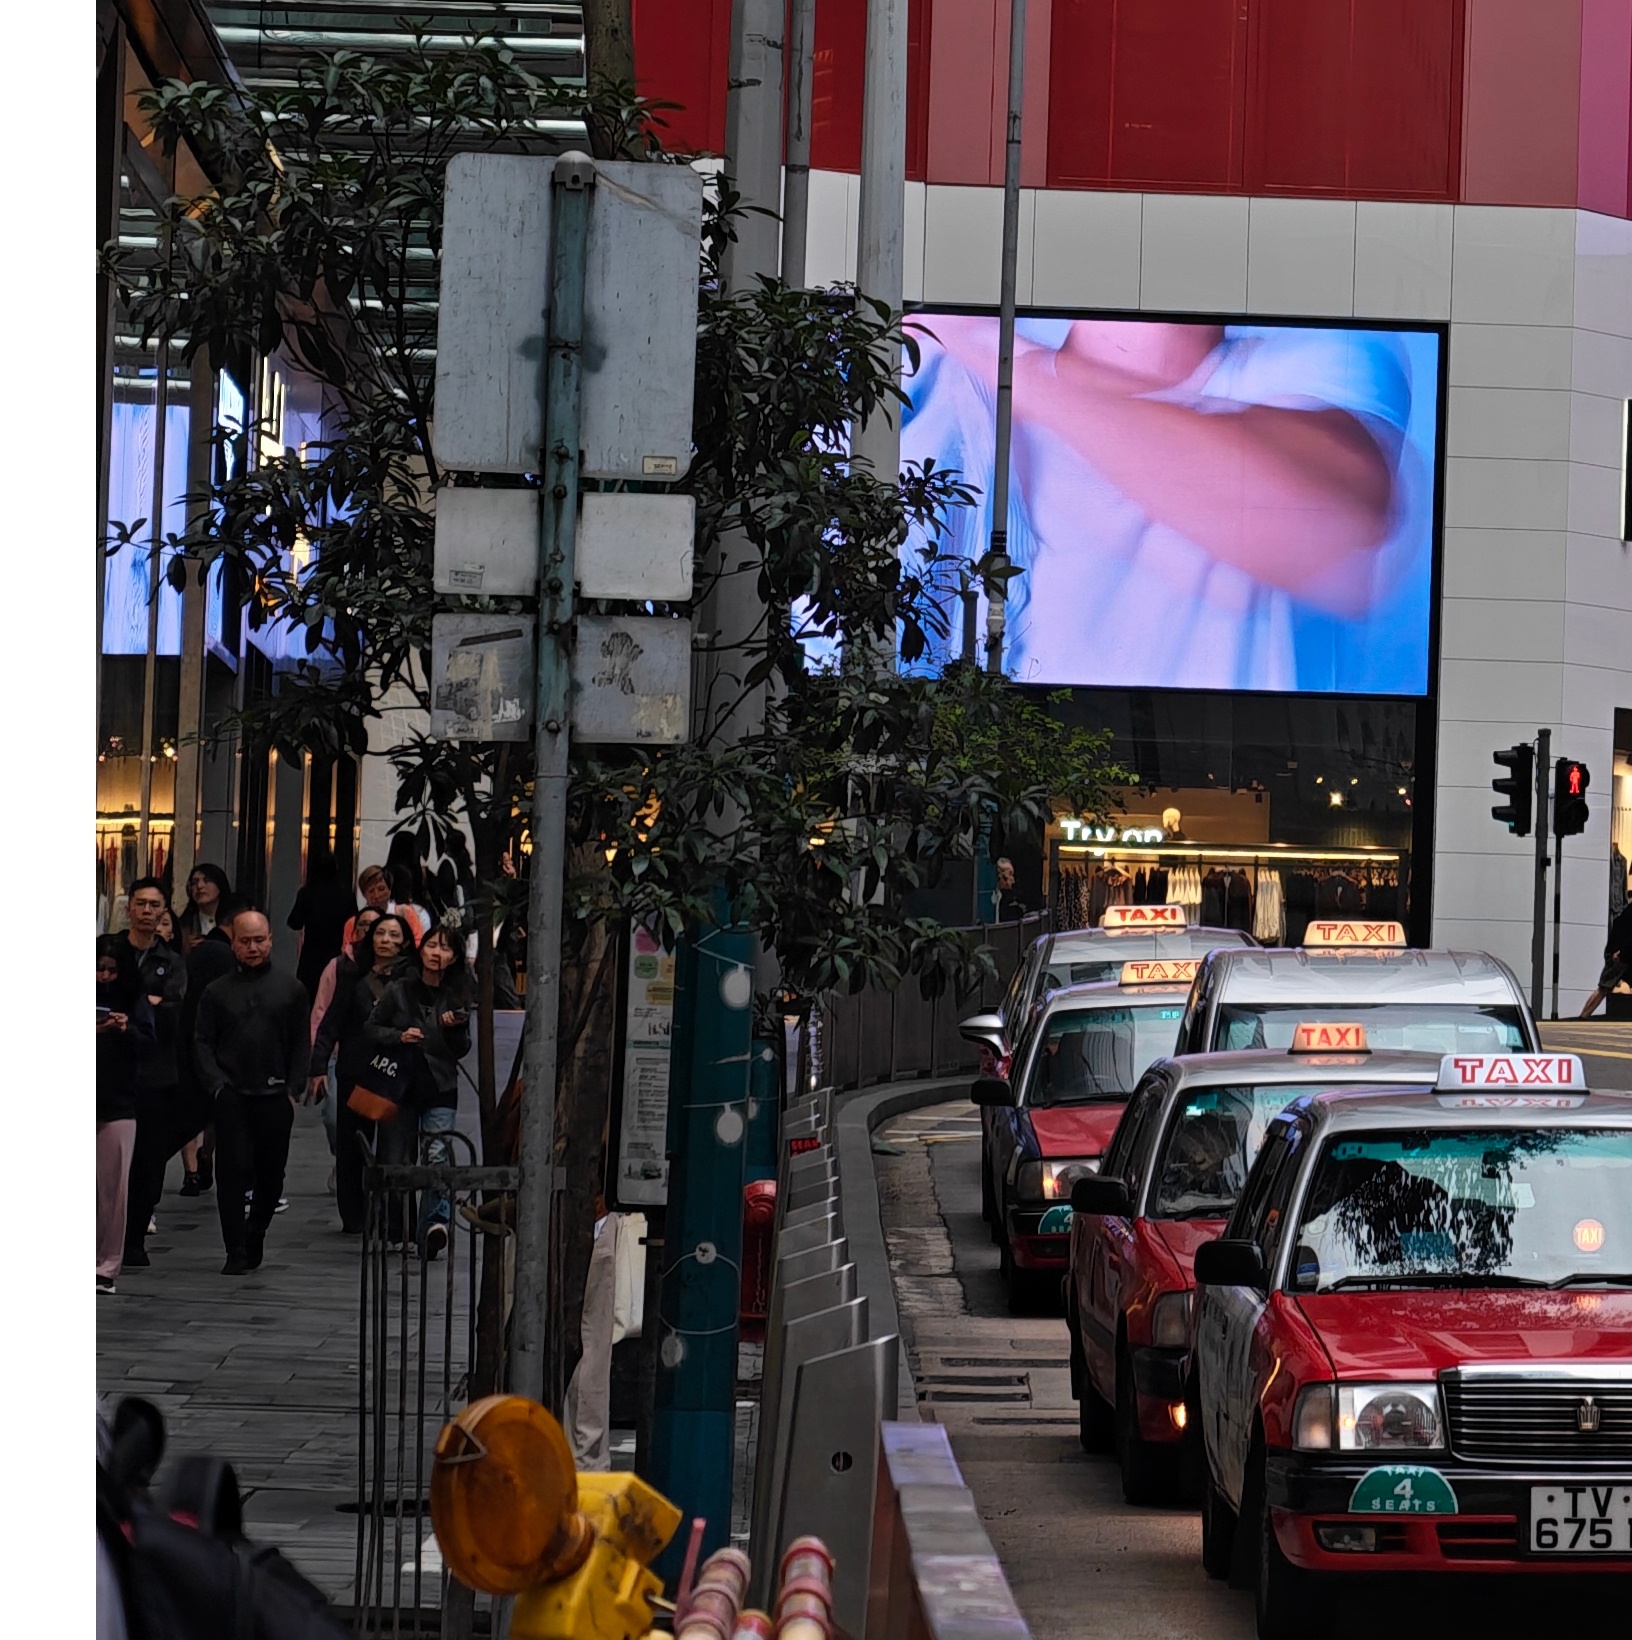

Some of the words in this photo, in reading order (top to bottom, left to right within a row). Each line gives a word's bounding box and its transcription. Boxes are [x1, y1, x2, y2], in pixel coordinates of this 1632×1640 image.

[1114, 908, 1177, 923] TAXI
[1316, 924, 1396, 942] TAXI
[1301, 1027, 1361, 1047] TAXI
[1454, 1058, 1573, 1085] TAXI
[1575, 1227, 1603, 1245] TAXI
[1393, 1477, 1414, 1500] 4
[1371, 1498, 1436, 1512] SEATS
[1563, 1487, 1613, 1518] TV
